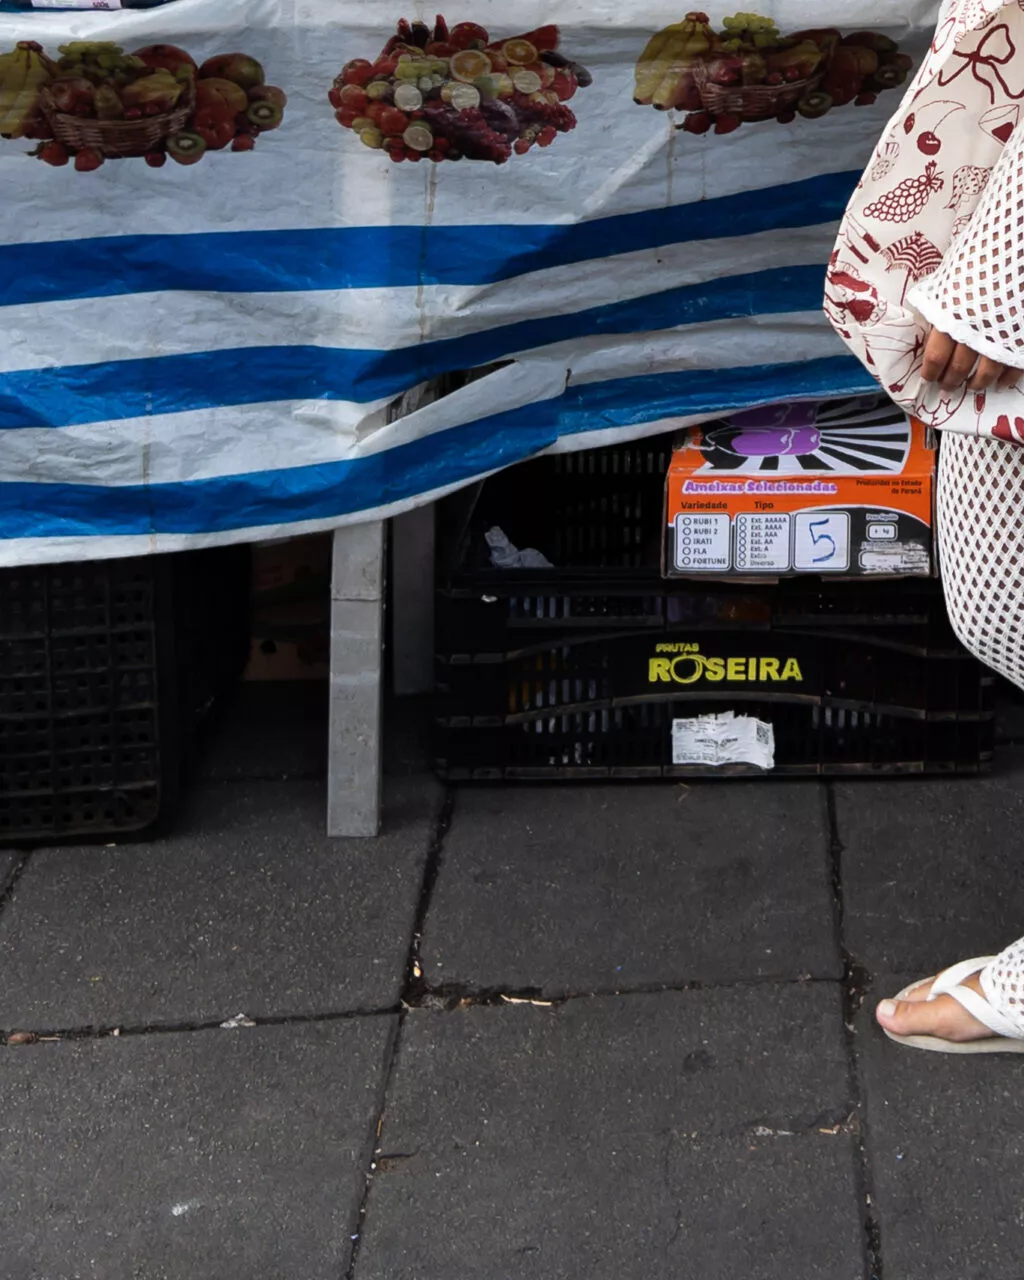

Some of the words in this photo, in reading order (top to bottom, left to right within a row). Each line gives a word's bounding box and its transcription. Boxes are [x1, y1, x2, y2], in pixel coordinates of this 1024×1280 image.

[683, 480, 745, 493] Ameixas
[745, 480, 838, 493] Selecionadas
[681, 501, 728, 509] Variedade
[754, 501, 774, 509] Tipo
[809, 518, 836, 563] 5
[656, 643, 699, 652] FRUTAS
[649, 654, 803, 684] ROSEIRA
